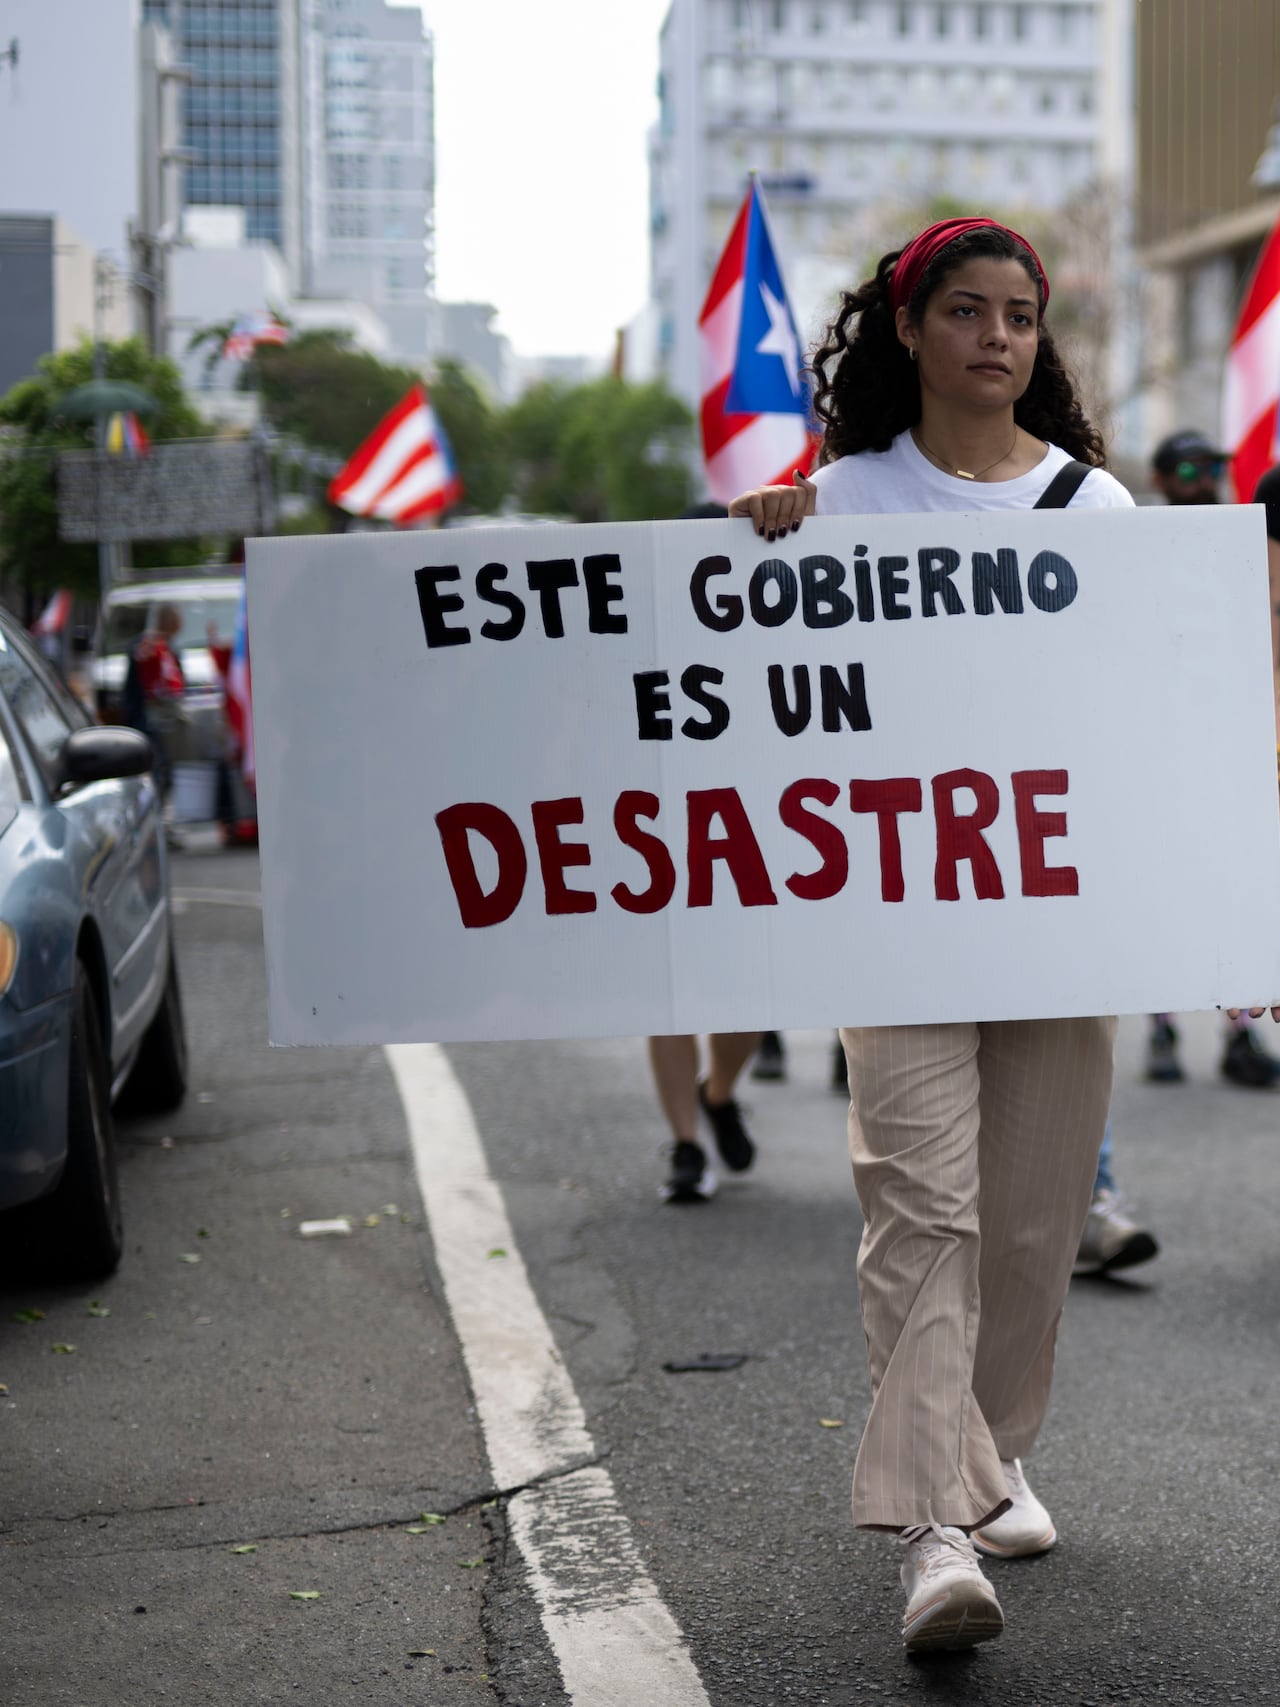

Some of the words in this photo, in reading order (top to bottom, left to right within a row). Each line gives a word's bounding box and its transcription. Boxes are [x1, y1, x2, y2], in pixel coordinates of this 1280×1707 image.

[413, 553, 629, 650] ESTE
[632, 663, 731, 742] ES
[767, 662, 873, 738] UN
[433, 767, 1079, 929] DESASTRE
